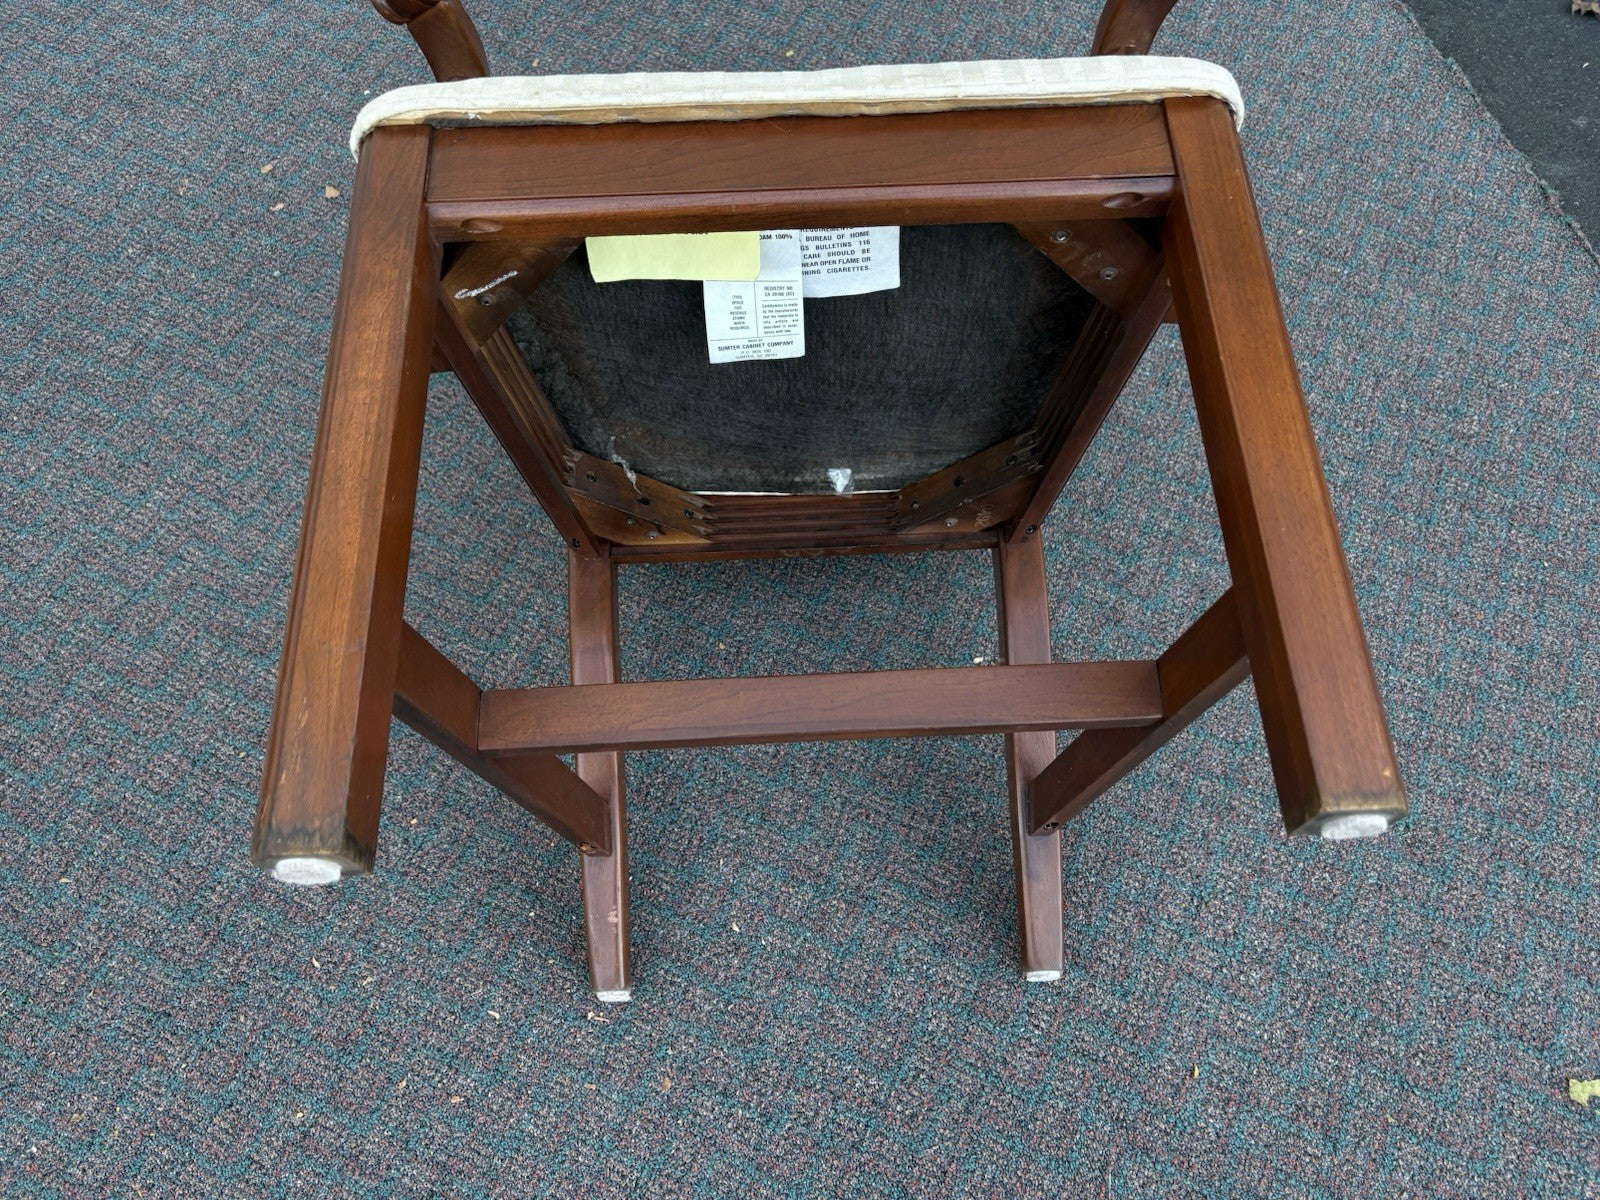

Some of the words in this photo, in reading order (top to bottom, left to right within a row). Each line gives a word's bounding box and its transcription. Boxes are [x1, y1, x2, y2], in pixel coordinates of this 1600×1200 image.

[850, 230, 870, 238] HOME
[815, 241, 852, 250] BULLETINS
[827, 249, 856, 257] SHOULD
[838, 257, 860, 265] FLAME
[826, 265, 870, 274] CIGARETTES.
[742, 342, 765, 350] CABINET
[767, 340, 794, 348] COMPANY
